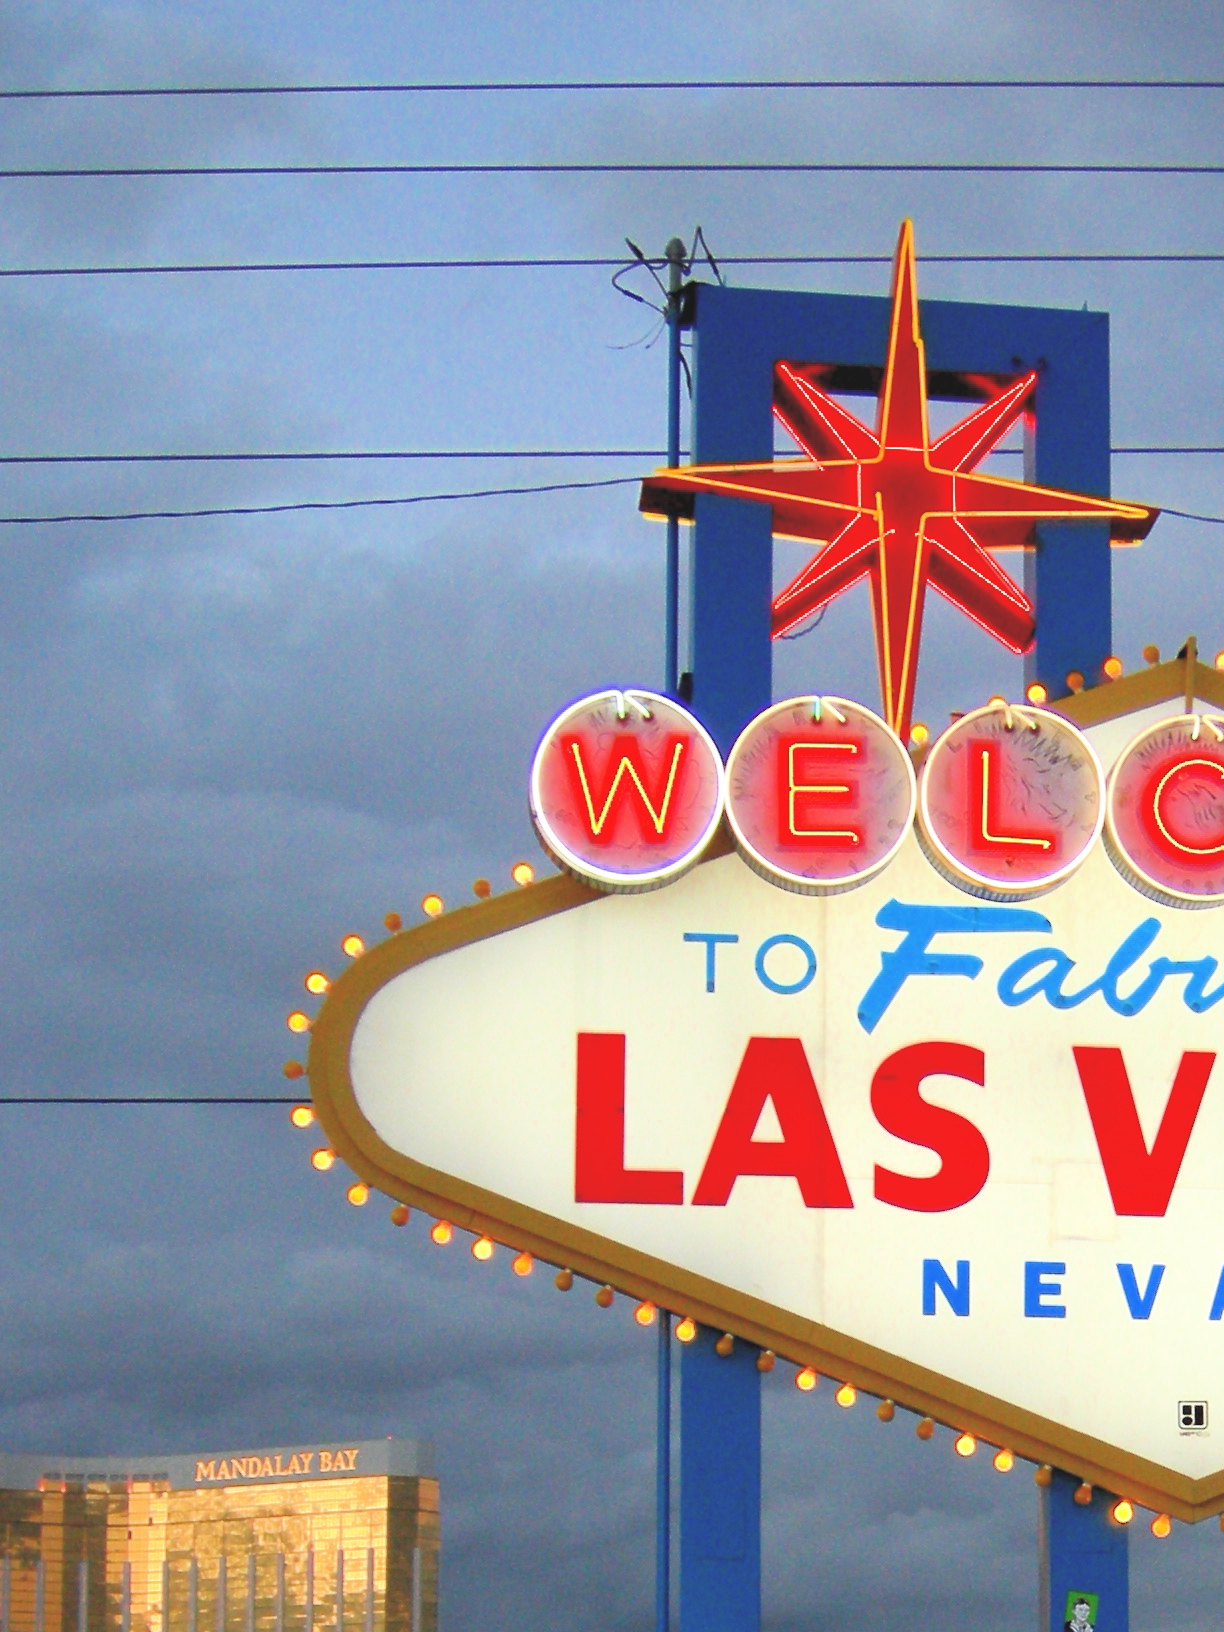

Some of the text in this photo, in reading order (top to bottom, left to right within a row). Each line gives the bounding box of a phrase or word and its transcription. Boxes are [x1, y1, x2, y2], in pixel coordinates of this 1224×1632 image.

[684, 931, 817, 995] TO
[574, 1031, 992, 1211] LAS
[194, 1448, 360, 1482] MANDALAY BAY
